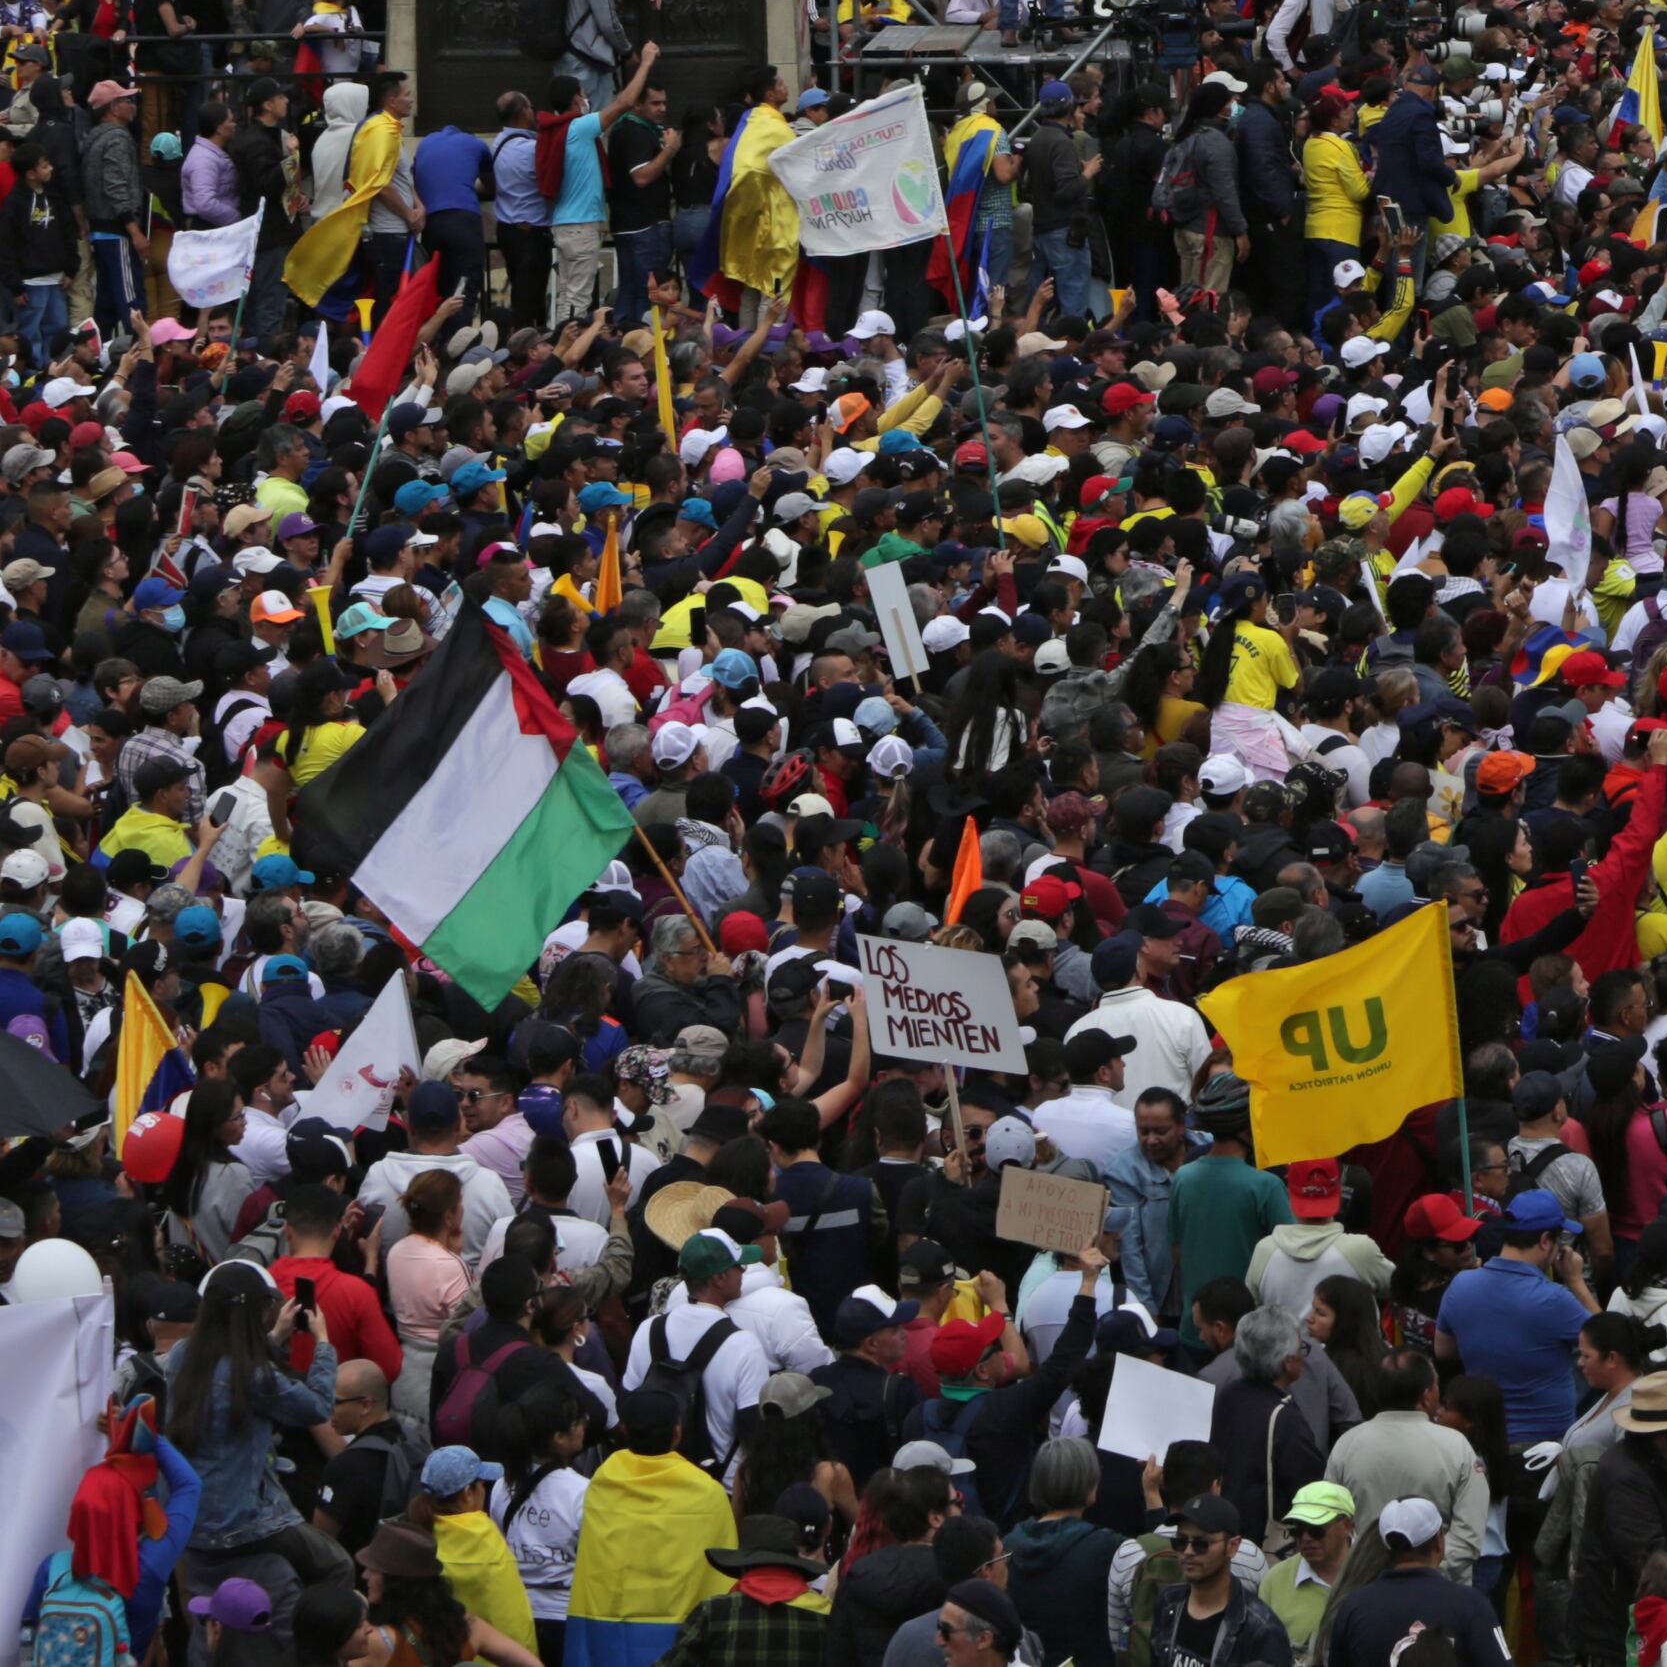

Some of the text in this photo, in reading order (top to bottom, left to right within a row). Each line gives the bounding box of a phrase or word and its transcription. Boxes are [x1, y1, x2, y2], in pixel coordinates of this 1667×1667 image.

[864, 938, 910, 985] LOS
[883, 986, 973, 1021] MEDIOS
[889, 1015, 1001, 1055] MIENTEN
[1025, 1176, 1078, 1204] APOYO
